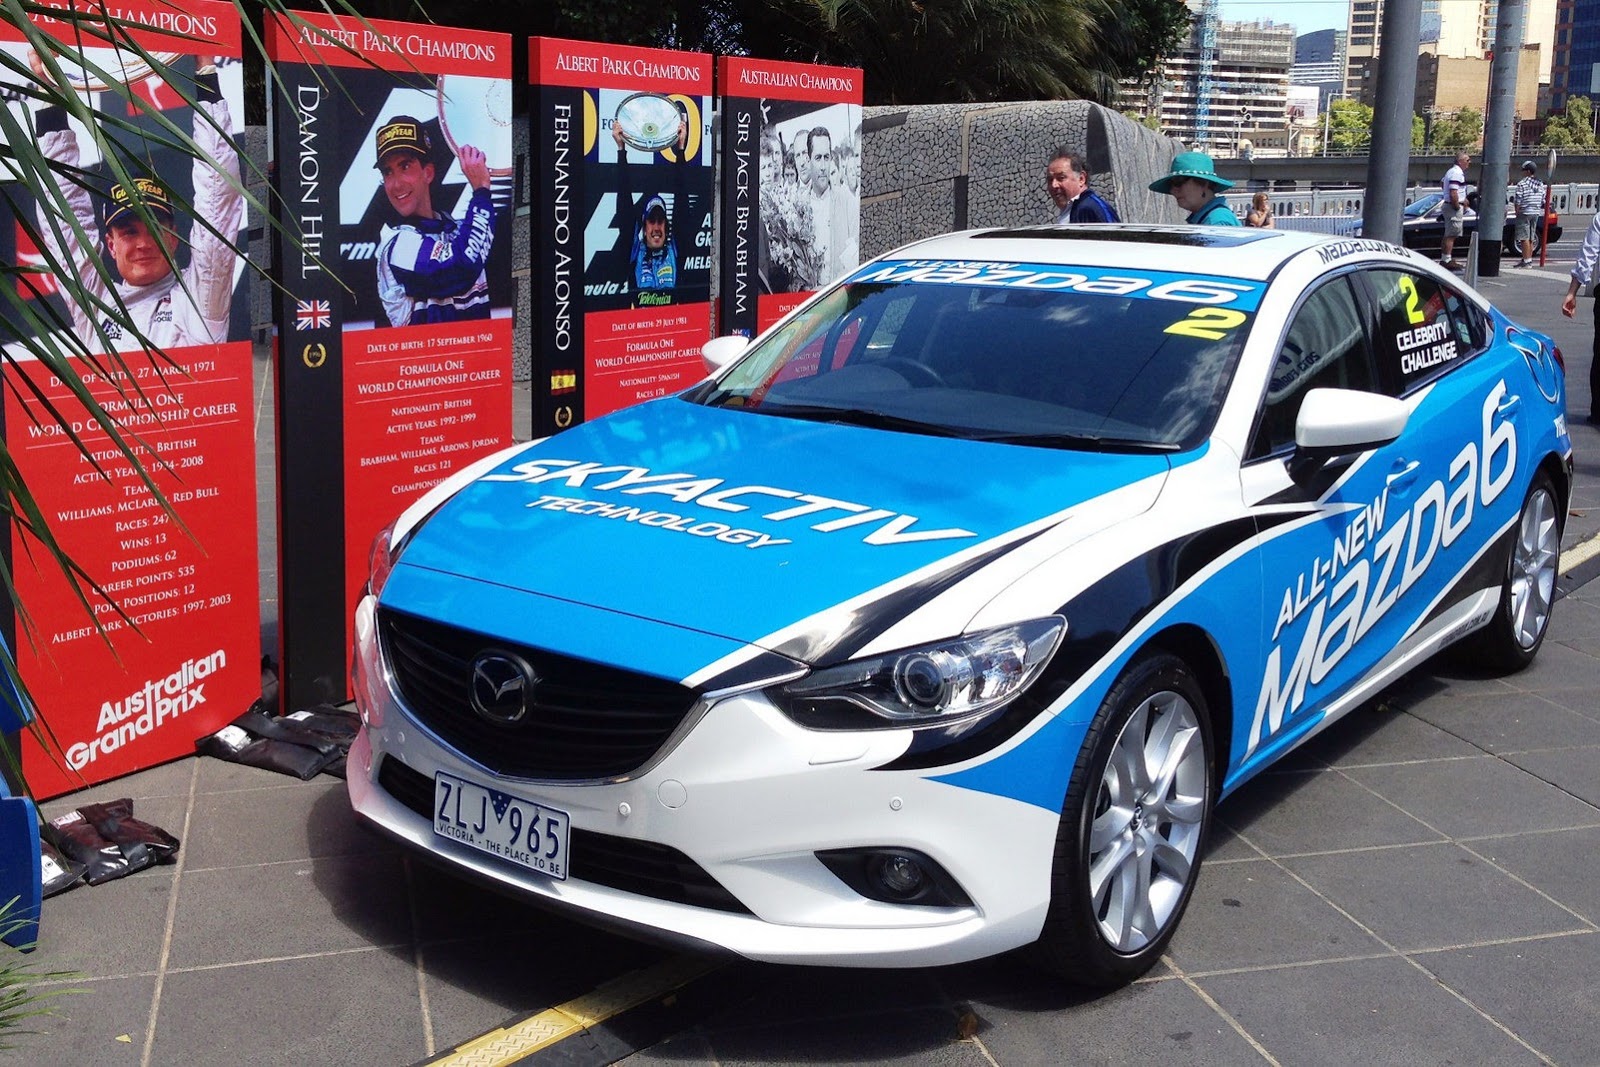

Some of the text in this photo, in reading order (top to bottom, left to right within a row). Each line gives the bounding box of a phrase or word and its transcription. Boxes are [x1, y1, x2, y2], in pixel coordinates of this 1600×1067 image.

[298, 26, 495, 62] ALBERT PARK CHAMPIONS
[555, 52, 700, 82] ALBERT PARK CHAMPIONS
[740, 69, 853, 92] AUSTRALIAN CHAMPIONS
[297, 84, 323, 280] DAMON HILL
[734, 111, 751, 315] SIR JACK BRABHAM
[554, 104, 572, 351] FERNANDO ALONSO
[895, 260, 1021, 271] ALL-NEW
[855, 266, 1256, 304] Mazda6
[1399, 276, 1425, 324] 2
[612, 323, 626, 332] DATE
[628, 322, 635, 330] OF
[656, 319, 662, 328] 29
[663, 318, 675, 328] JULY
[675, 317, 687, 325] 1981
[1163, 306, 1247, 341] 2
[1396, 321, 1448, 352] CELEBRITY
[367, 344, 387, 353] DATE
[388, 342, 399, 351] OF
[427, 339, 435, 348] 17
[437, 336, 475, 348] SEPTEMBER
[477, 333, 493, 343] 1960
[627, 339, 674, 352] FORMULA ONE
[1400, 340, 1458, 374] CHALLENGE
[400, 359, 464, 376] FORMULA ONE
[596, 347, 701, 368] WORLD CHAMPIONSHIP CAREER
[82, 373, 97, 384] OF
[138, 367, 149, 378] 27
[193, 361, 215, 372] 1971
[358, 369, 501, 395] WORLD CHAMPIONSHIP CAREER
[658, 372, 680, 383] SPANISH
[156, 393, 184, 406] ONE
[444, 399, 472, 410] BRITISH
[656, 387, 665, 397] 178
[28, 422, 82, 438] WORD
[193, 403, 237, 417] CAREER
[386, 422, 413, 434] ACTIVE
[439, 413, 477, 427] 1992-1999
[157, 438, 197, 452] BRITISH
[472, 437, 499, 449] JORDAN
[73, 470, 112, 484] ACTIVE
[439, 460, 451, 470] 121
[57, 504, 115, 522] WILLIAMS,
[173, 489, 192, 502] RED
[196, 486, 219, 498] BULL
[478, 457, 978, 546] SKYACTIV
[115, 513, 170, 532] RACES: 247
[525, 494, 793, 549] TECHNOLOGY
[120, 533, 167, 550] WINS: 13
[111, 550, 177, 572] PODIUMS: 62
[1240, 378, 1517, 767] Mazda6
[1272, 486, 1388, 642] ALL-NEW
[92, 565, 195, 595] CAREER POINTS: 535
[124, 588, 181, 607] POSITIONS:
[183, 584, 196, 596] 12
[52, 626, 92, 644] ALBERT
[209, 594, 232, 608] 2003
[96, 649, 226, 732] Australian
[65, 681, 207, 771] Grand Prix
[438, 781, 560, 860] ZLJ 965
[439, 823, 474, 844] VICTORIA
[486, 839, 501, 854] THE
[505, 847, 530, 864] PLACE
[534, 856, 545, 869] TO
[549, 862, 560, 876] BE
